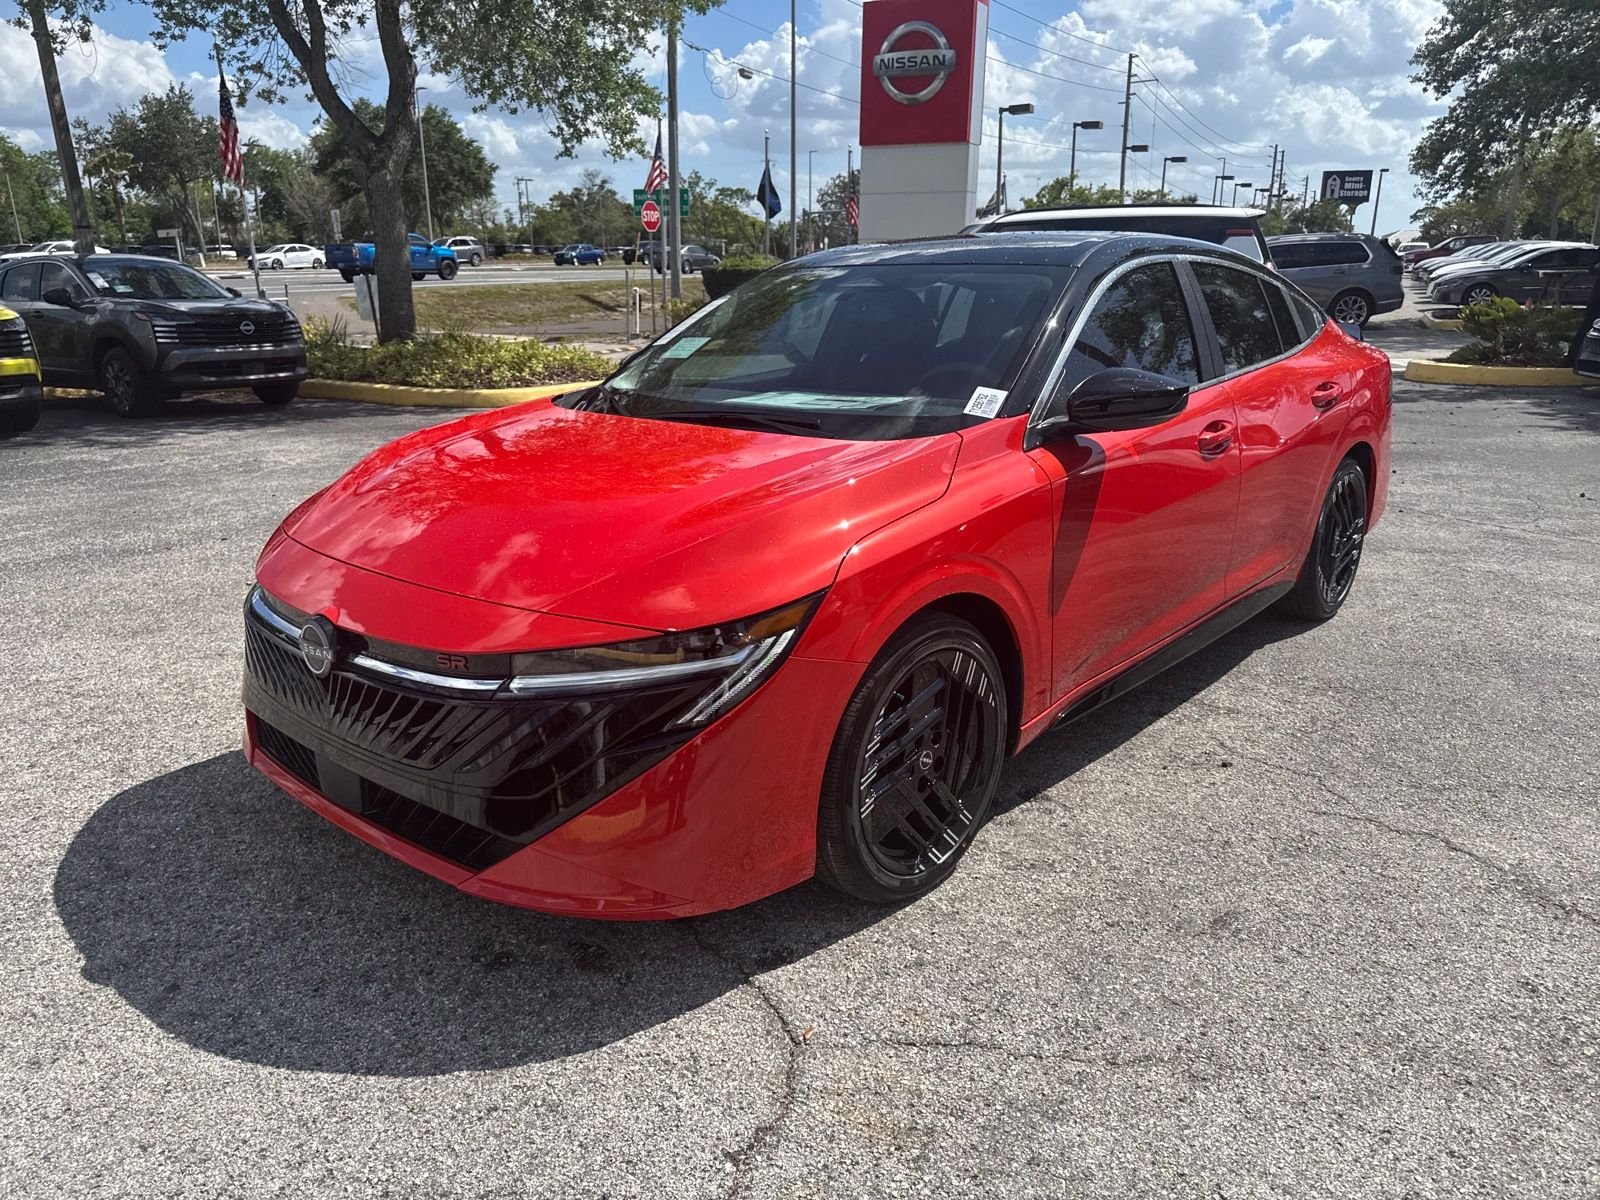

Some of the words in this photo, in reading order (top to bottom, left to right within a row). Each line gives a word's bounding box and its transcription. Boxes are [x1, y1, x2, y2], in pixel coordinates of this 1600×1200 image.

[879, 54, 946, 71] NISSAN
[1339, 189, 1368, 197] Storage
[643, 210, 659, 222] STOP
[436, 655, 469, 671] SR
